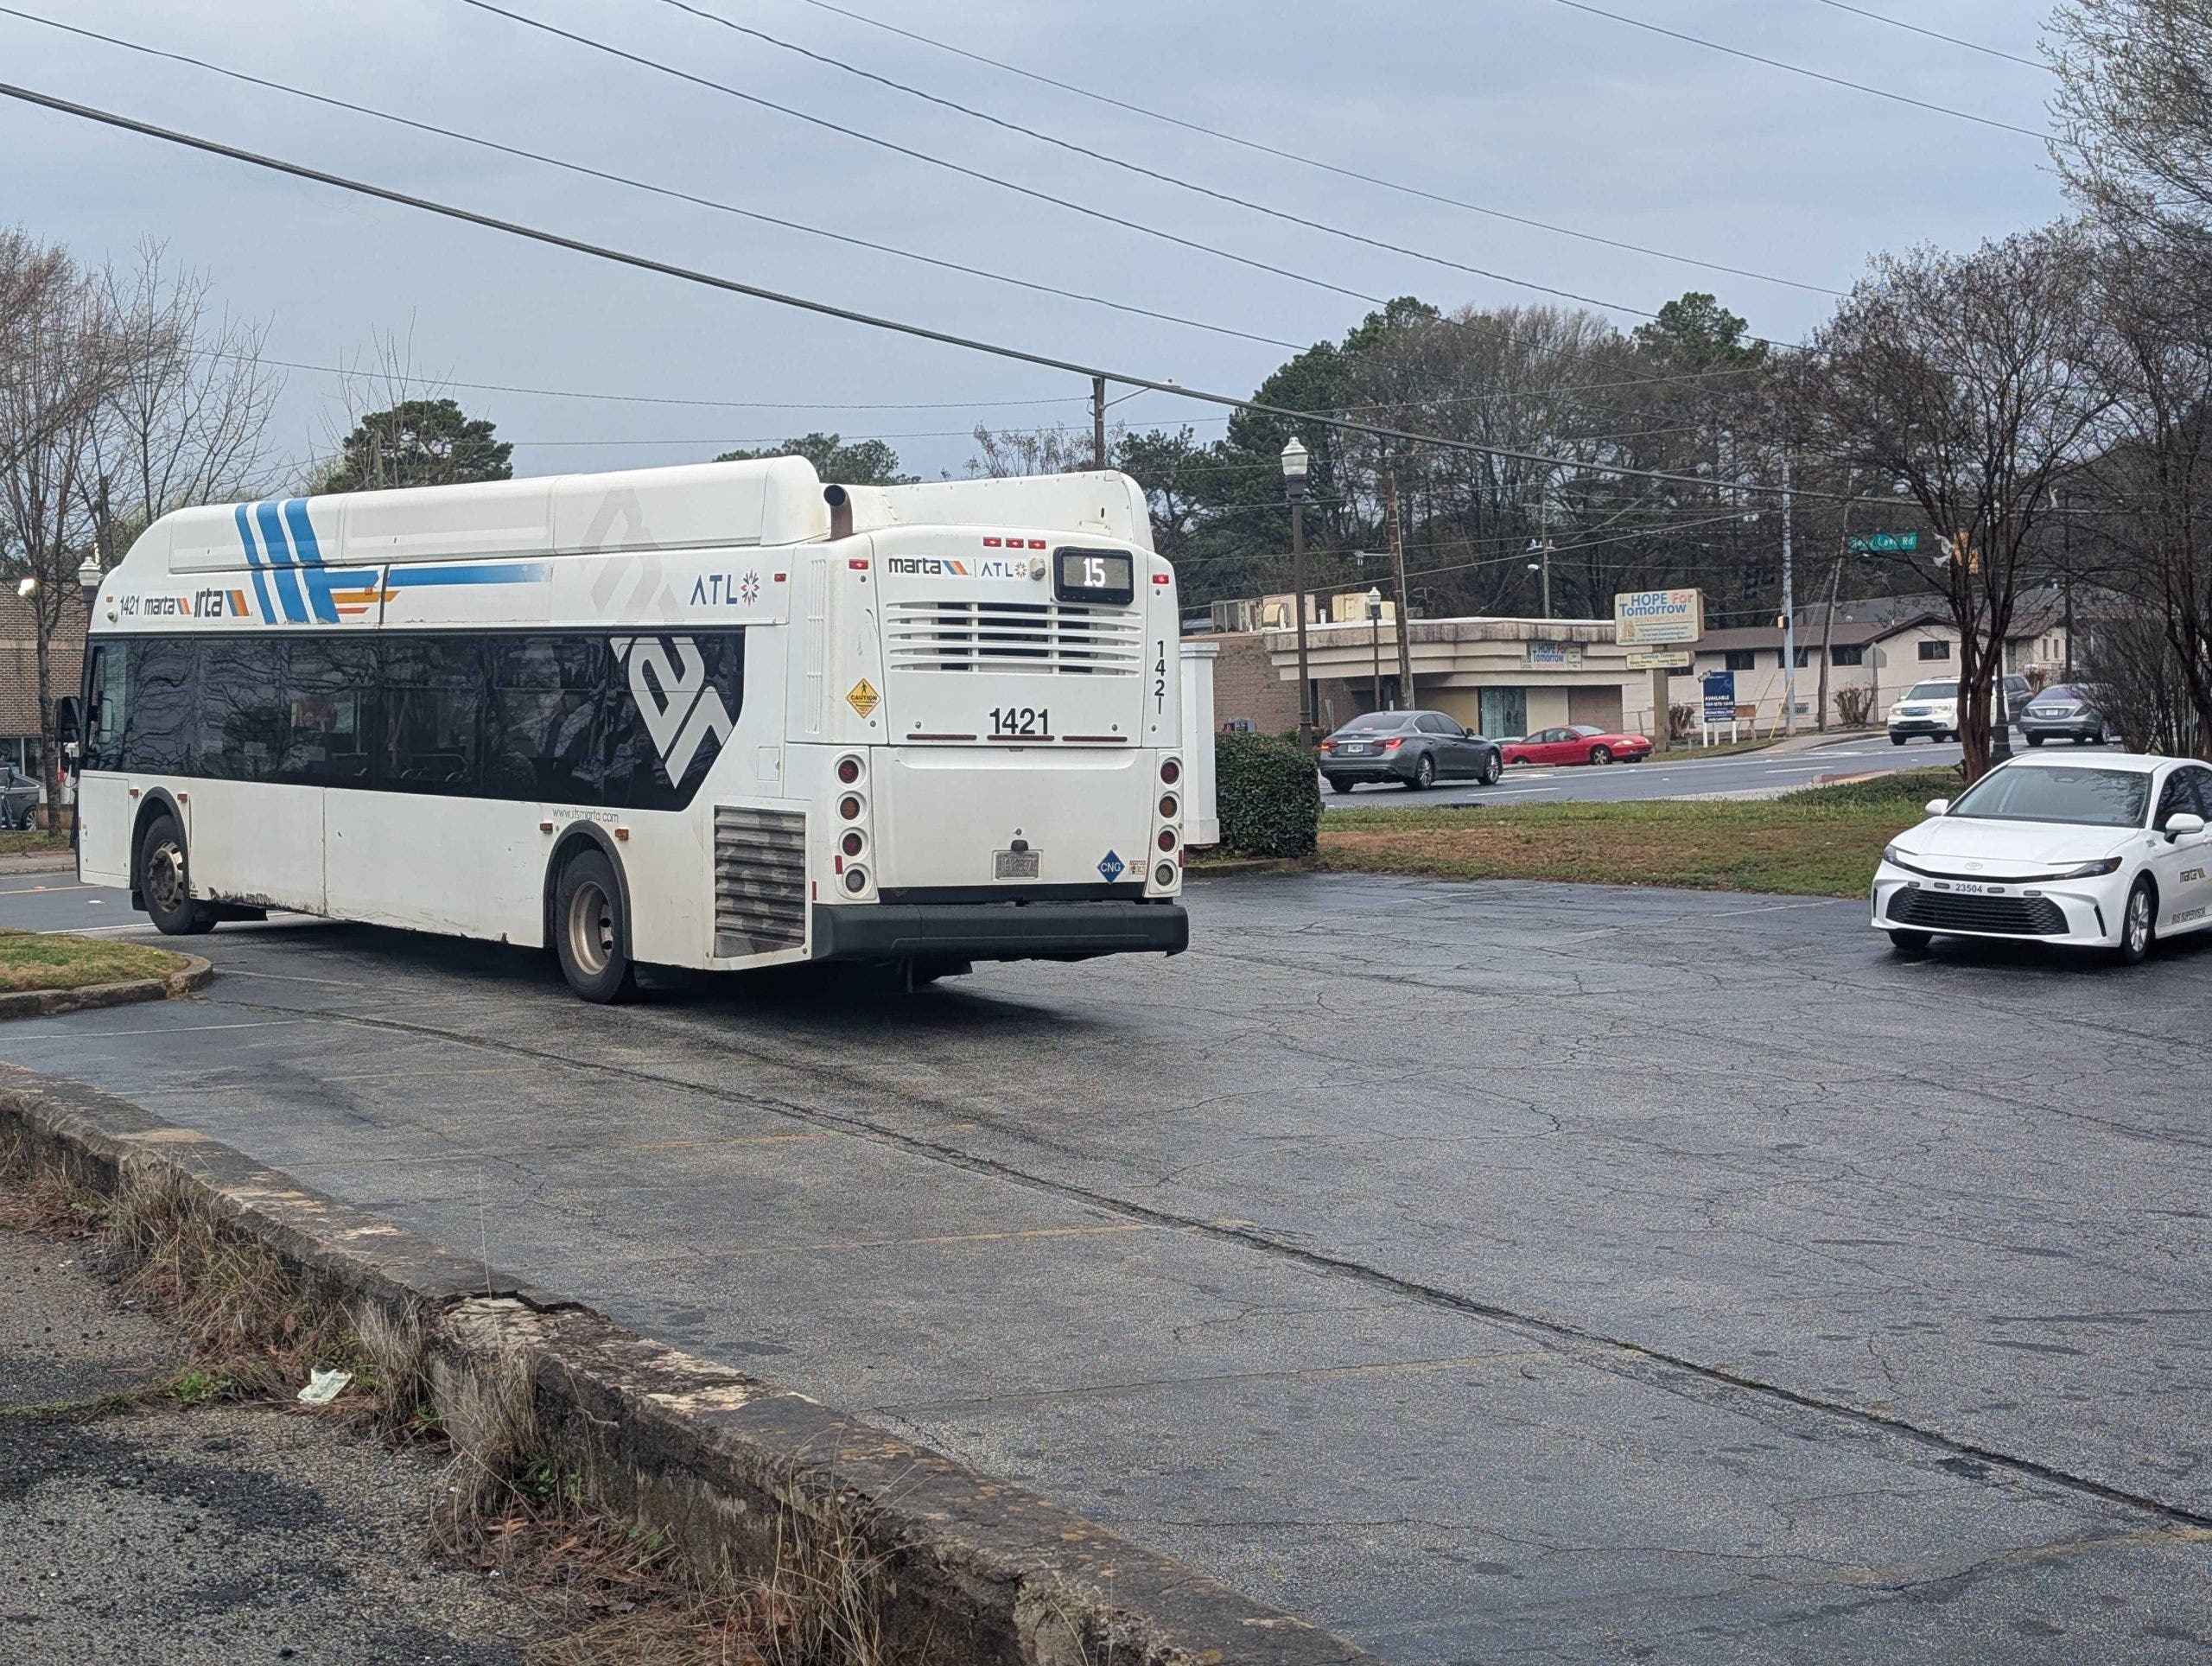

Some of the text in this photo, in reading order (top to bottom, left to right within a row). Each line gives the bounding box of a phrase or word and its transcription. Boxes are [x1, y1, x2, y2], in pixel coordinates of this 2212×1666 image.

[1902, 537, 1914, 545] Rd
[889, 557, 1014, 578] marta ATL
[1082, 557, 1106, 588] 15
[690, 574, 738, 606] ATL
[120, 595, 175, 615] 1421 marta
[1630, 591, 1694, 607] HOPE For
[1618, 602, 1687, 617] Tomorrow
[1538, 642, 1556, 654] HOPE
[1533, 649, 1564, 663] Tomorrow
[989, 708, 1049, 735] 1421
[1100, 862, 1122, 873] CNG
[1955, 883, 1983, 893] 23504
